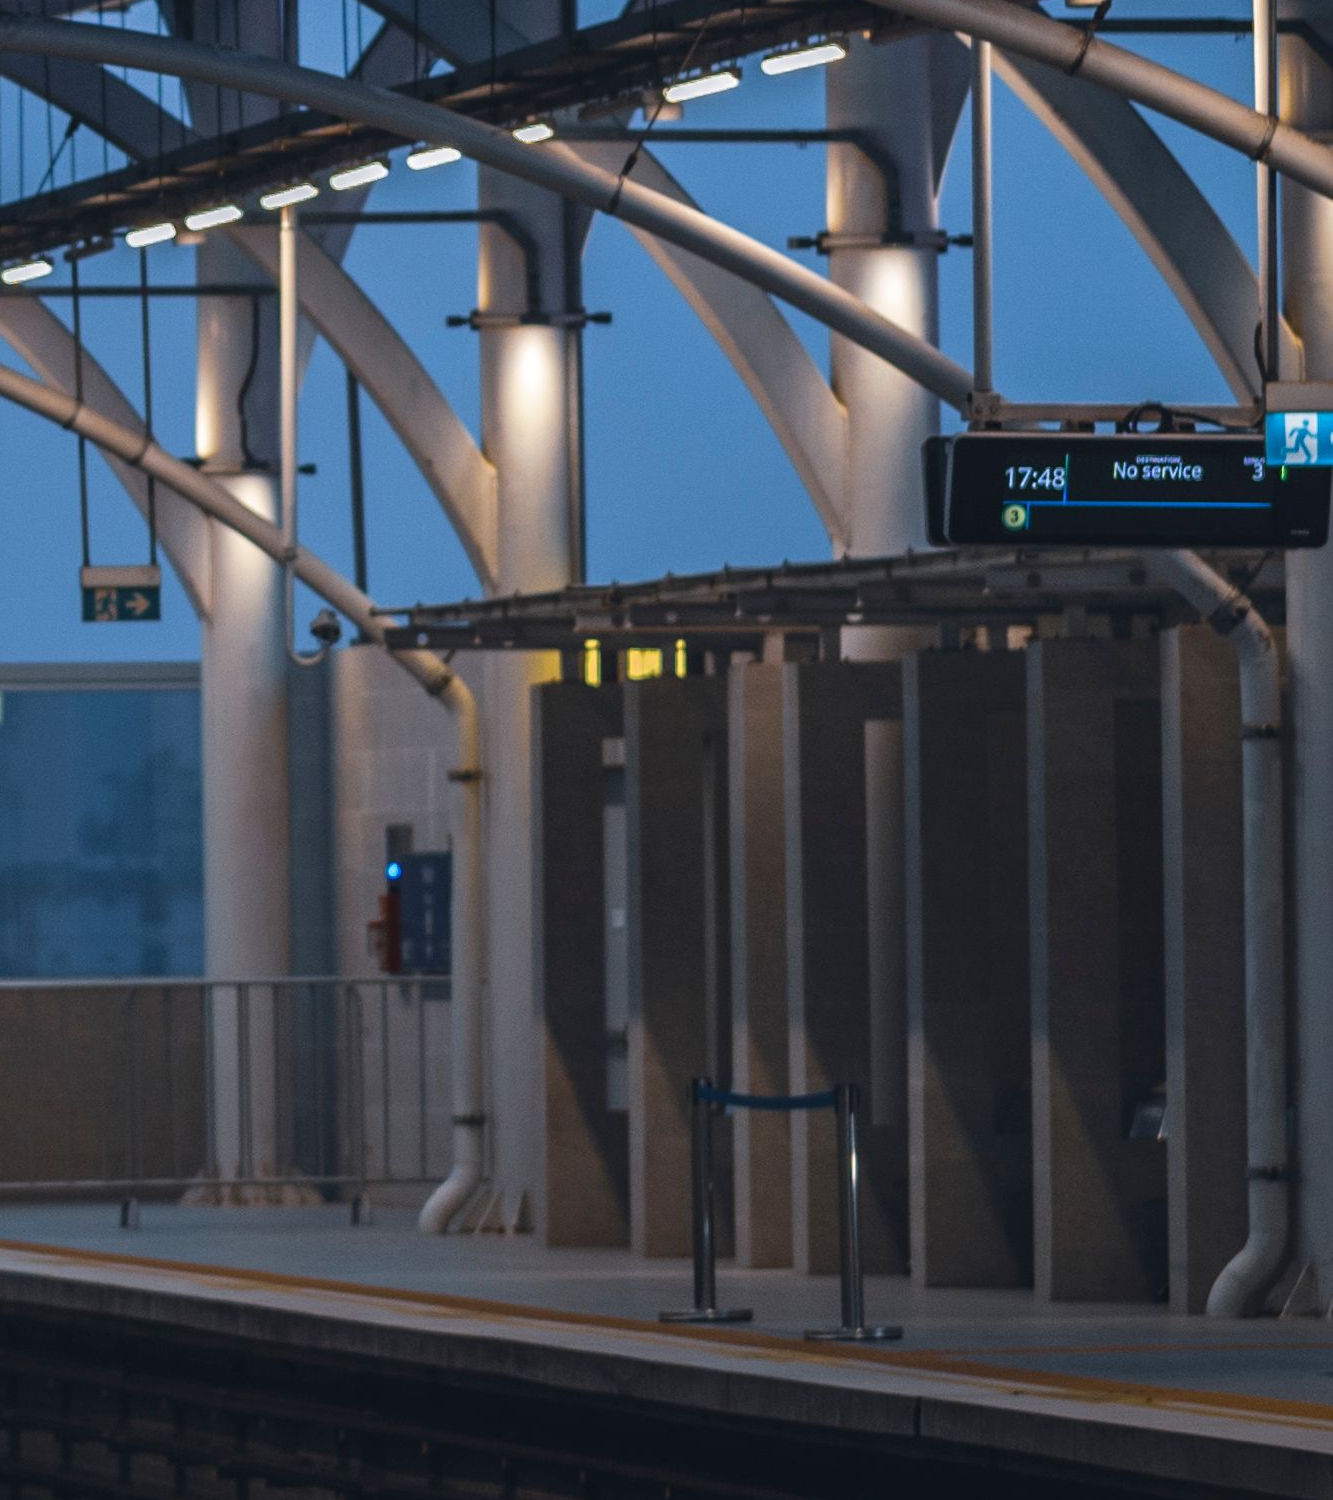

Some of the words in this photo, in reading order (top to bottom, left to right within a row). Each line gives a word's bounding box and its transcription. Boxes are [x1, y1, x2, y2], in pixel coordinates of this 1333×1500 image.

[1005, 466, 1065, 490] 17:48
[1113, 461, 1138, 480] No
[1142, 461, 1203, 481] service
[1011, 509, 1019, 523] 3
